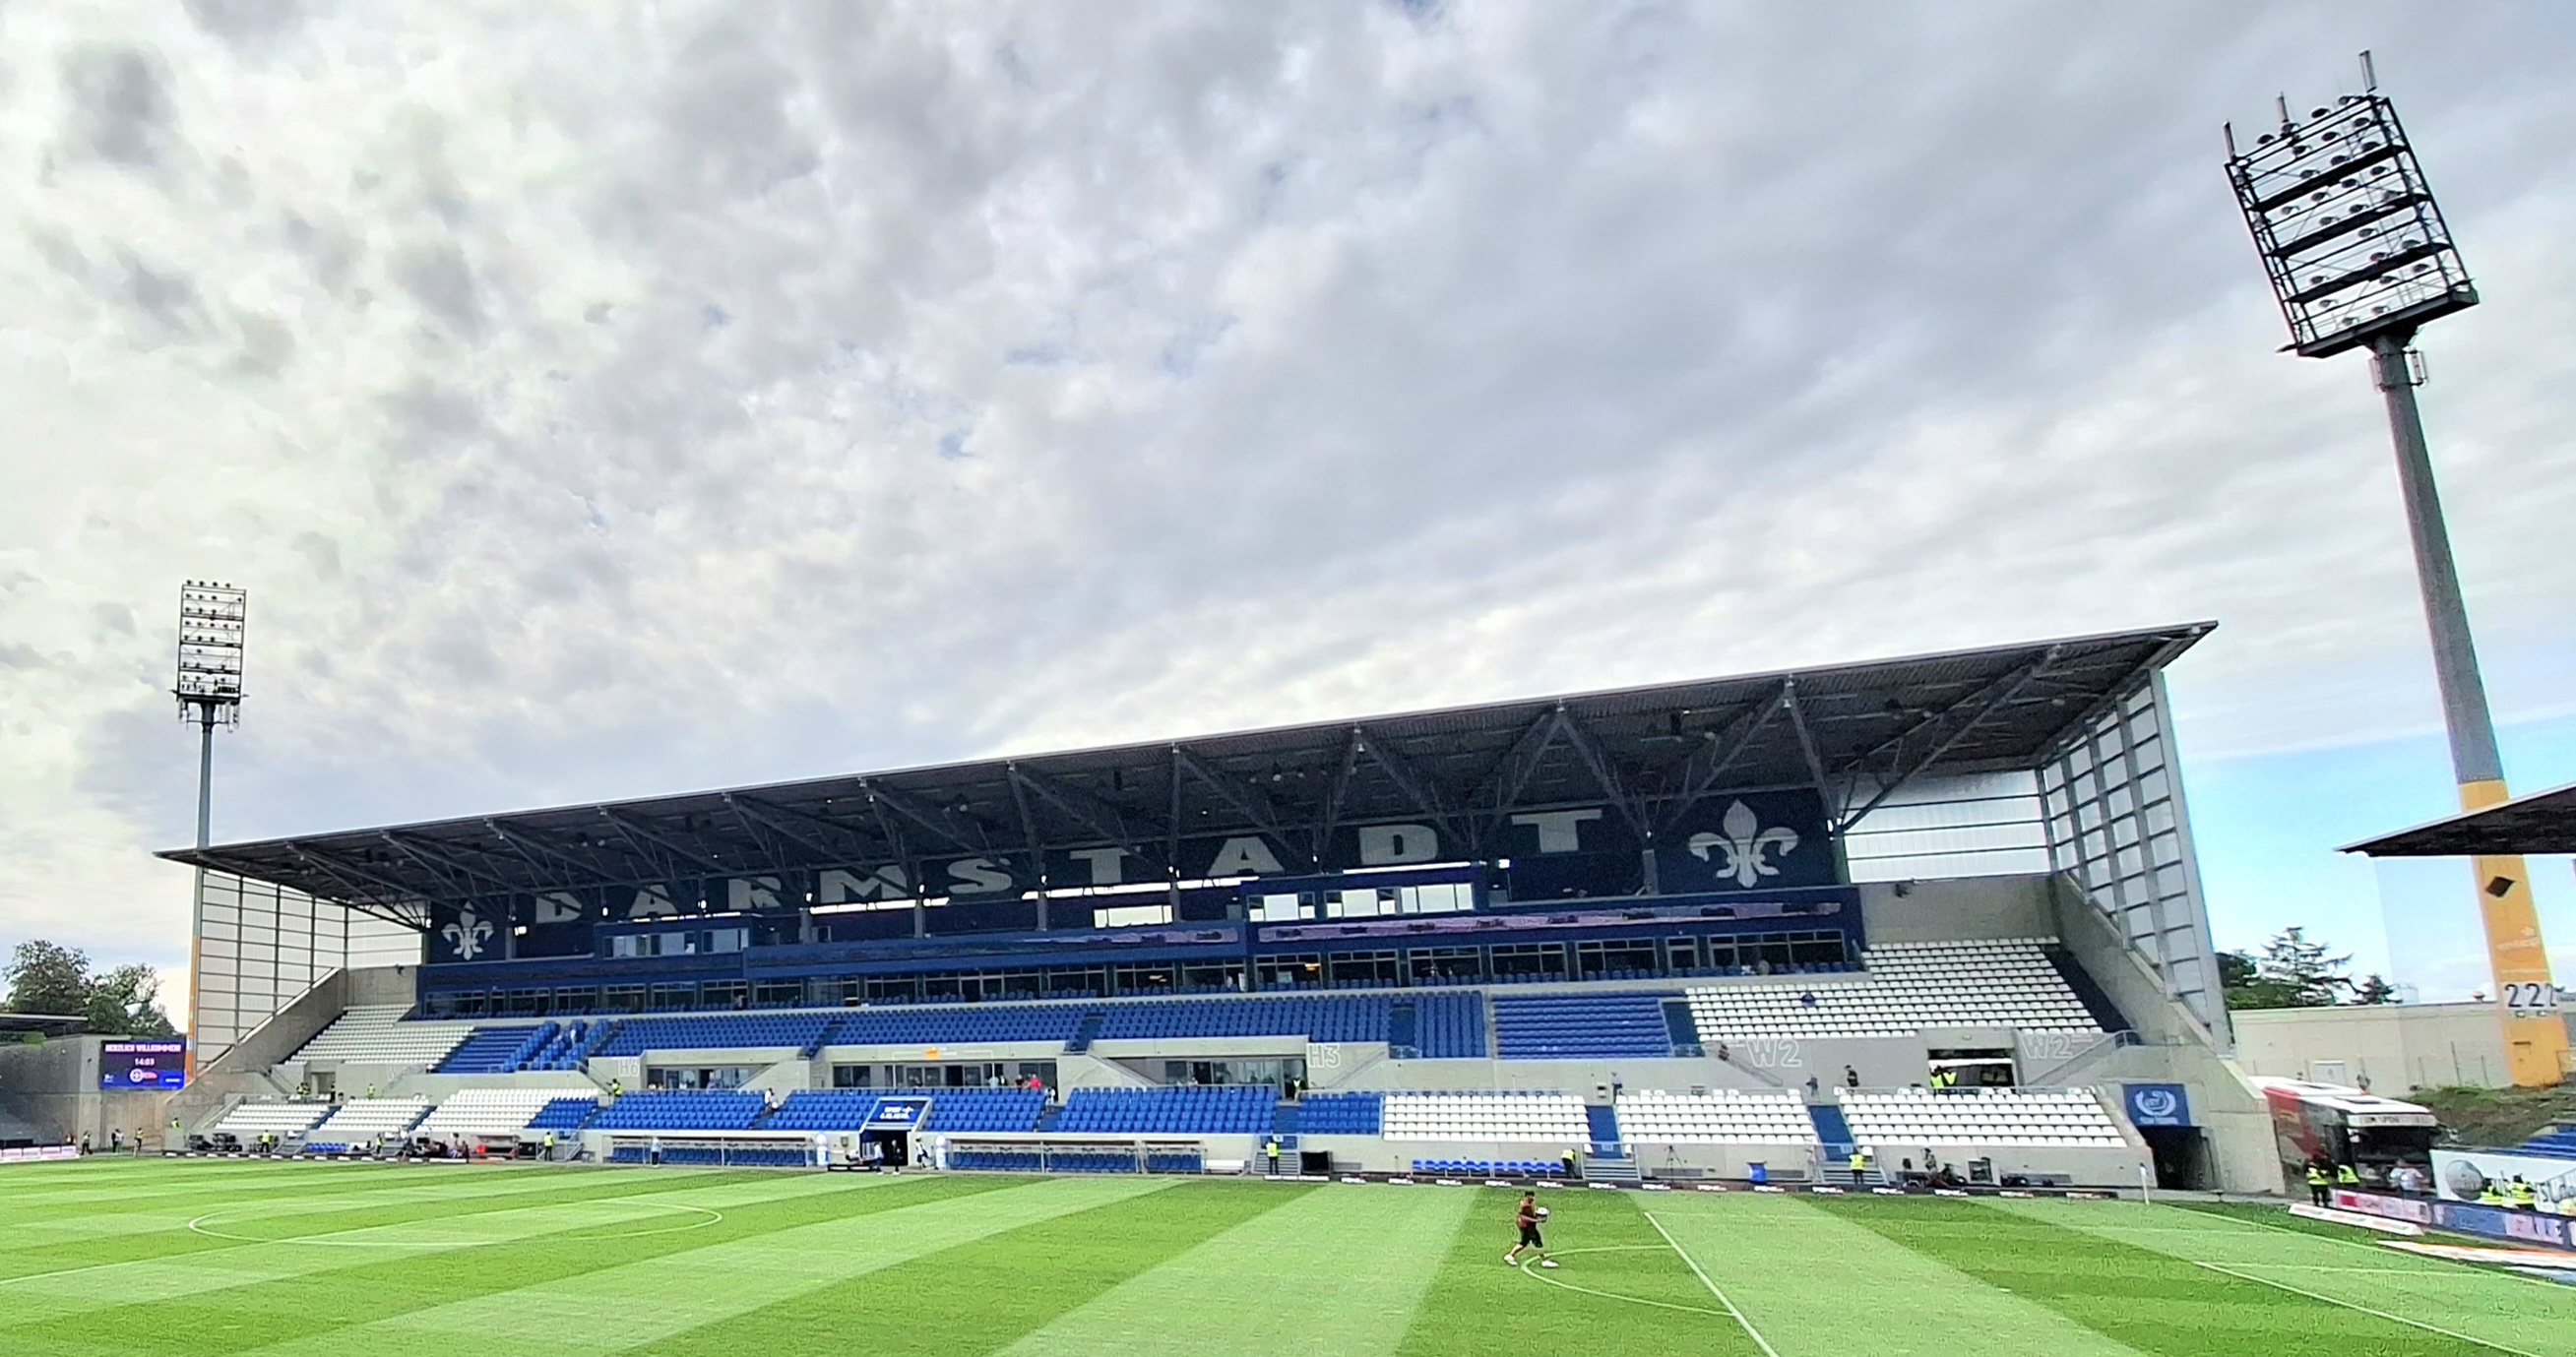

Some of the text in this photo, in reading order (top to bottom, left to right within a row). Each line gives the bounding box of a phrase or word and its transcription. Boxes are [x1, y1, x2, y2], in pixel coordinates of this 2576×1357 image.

[535, 808, 1602, 924] DARMSTADT
[1306, 1043, 1341, 1069] H3
[1746, 1037, 1801, 1067] W2
[2017, 1031, 2073, 1059] W2
[618, 1056, 641, 1078] H6
